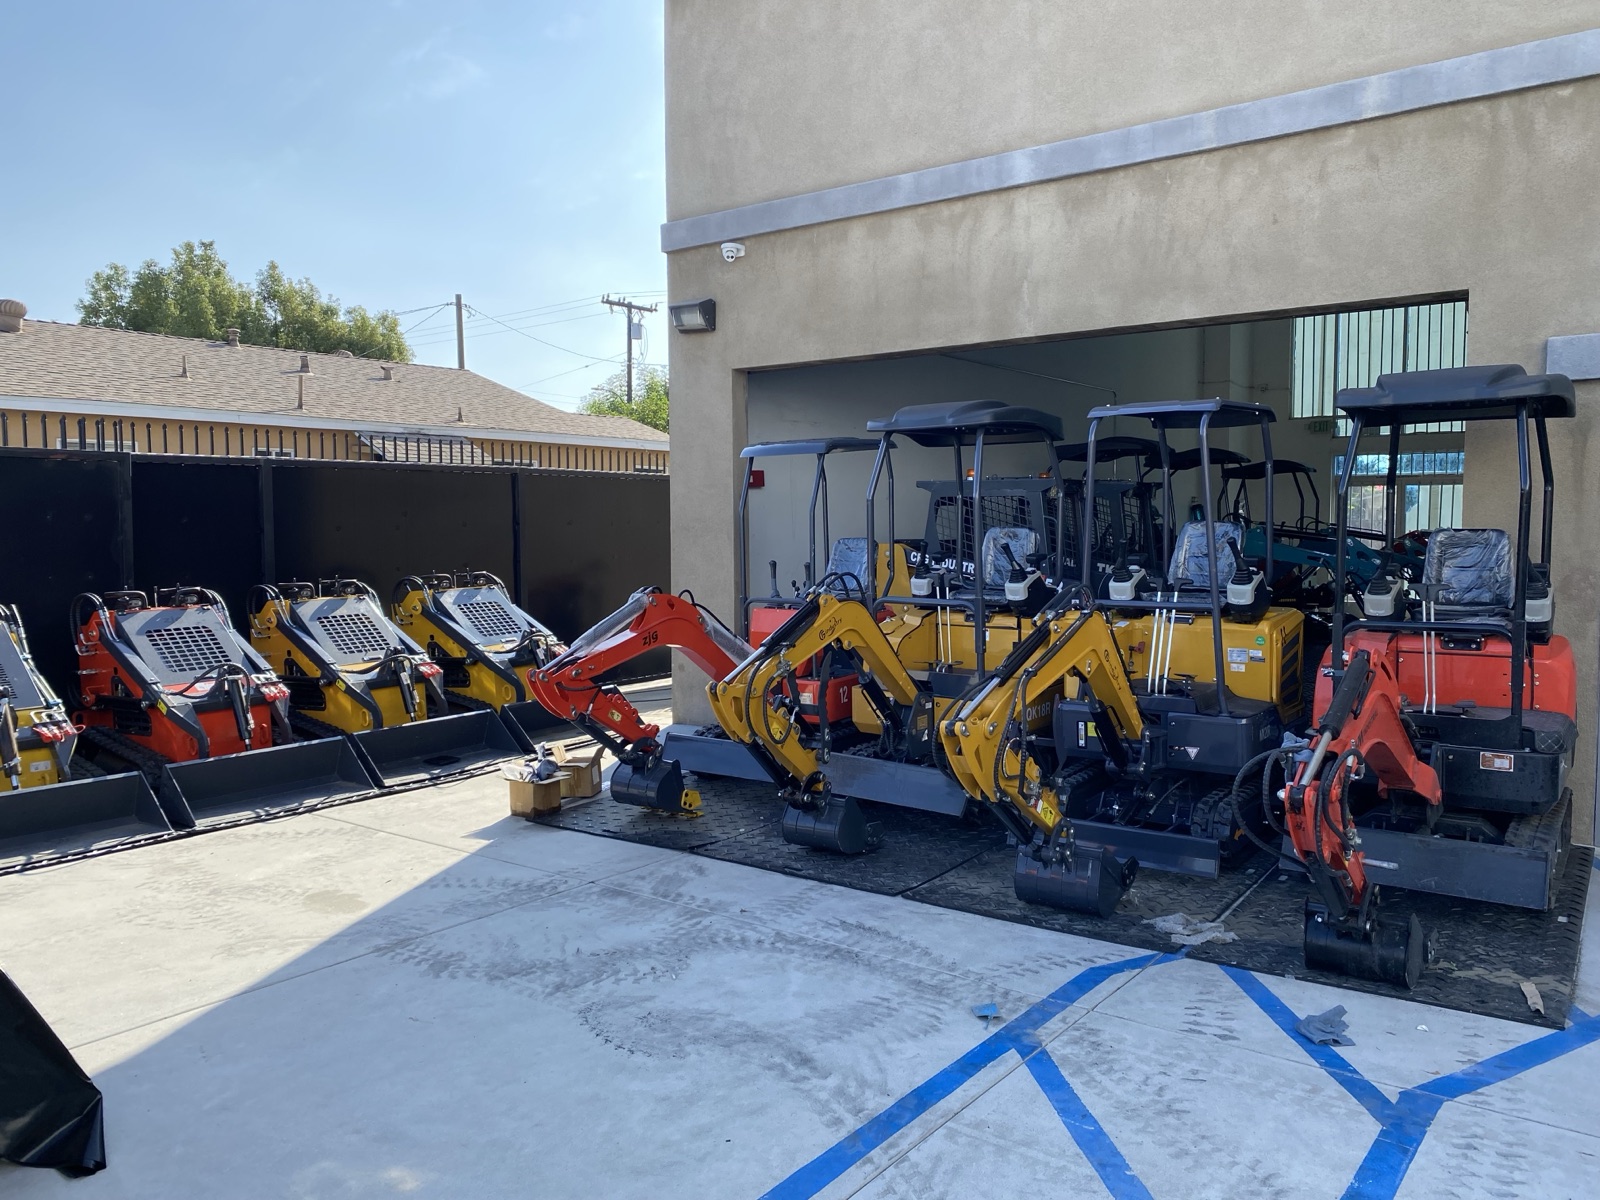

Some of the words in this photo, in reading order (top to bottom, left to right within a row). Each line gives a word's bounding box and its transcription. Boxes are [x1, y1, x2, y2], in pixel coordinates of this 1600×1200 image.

[1313, 420, 1329, 432] EXIT
[839, 685, 849, 704] 12
[1026, 701, 1051, 721] QK18R
